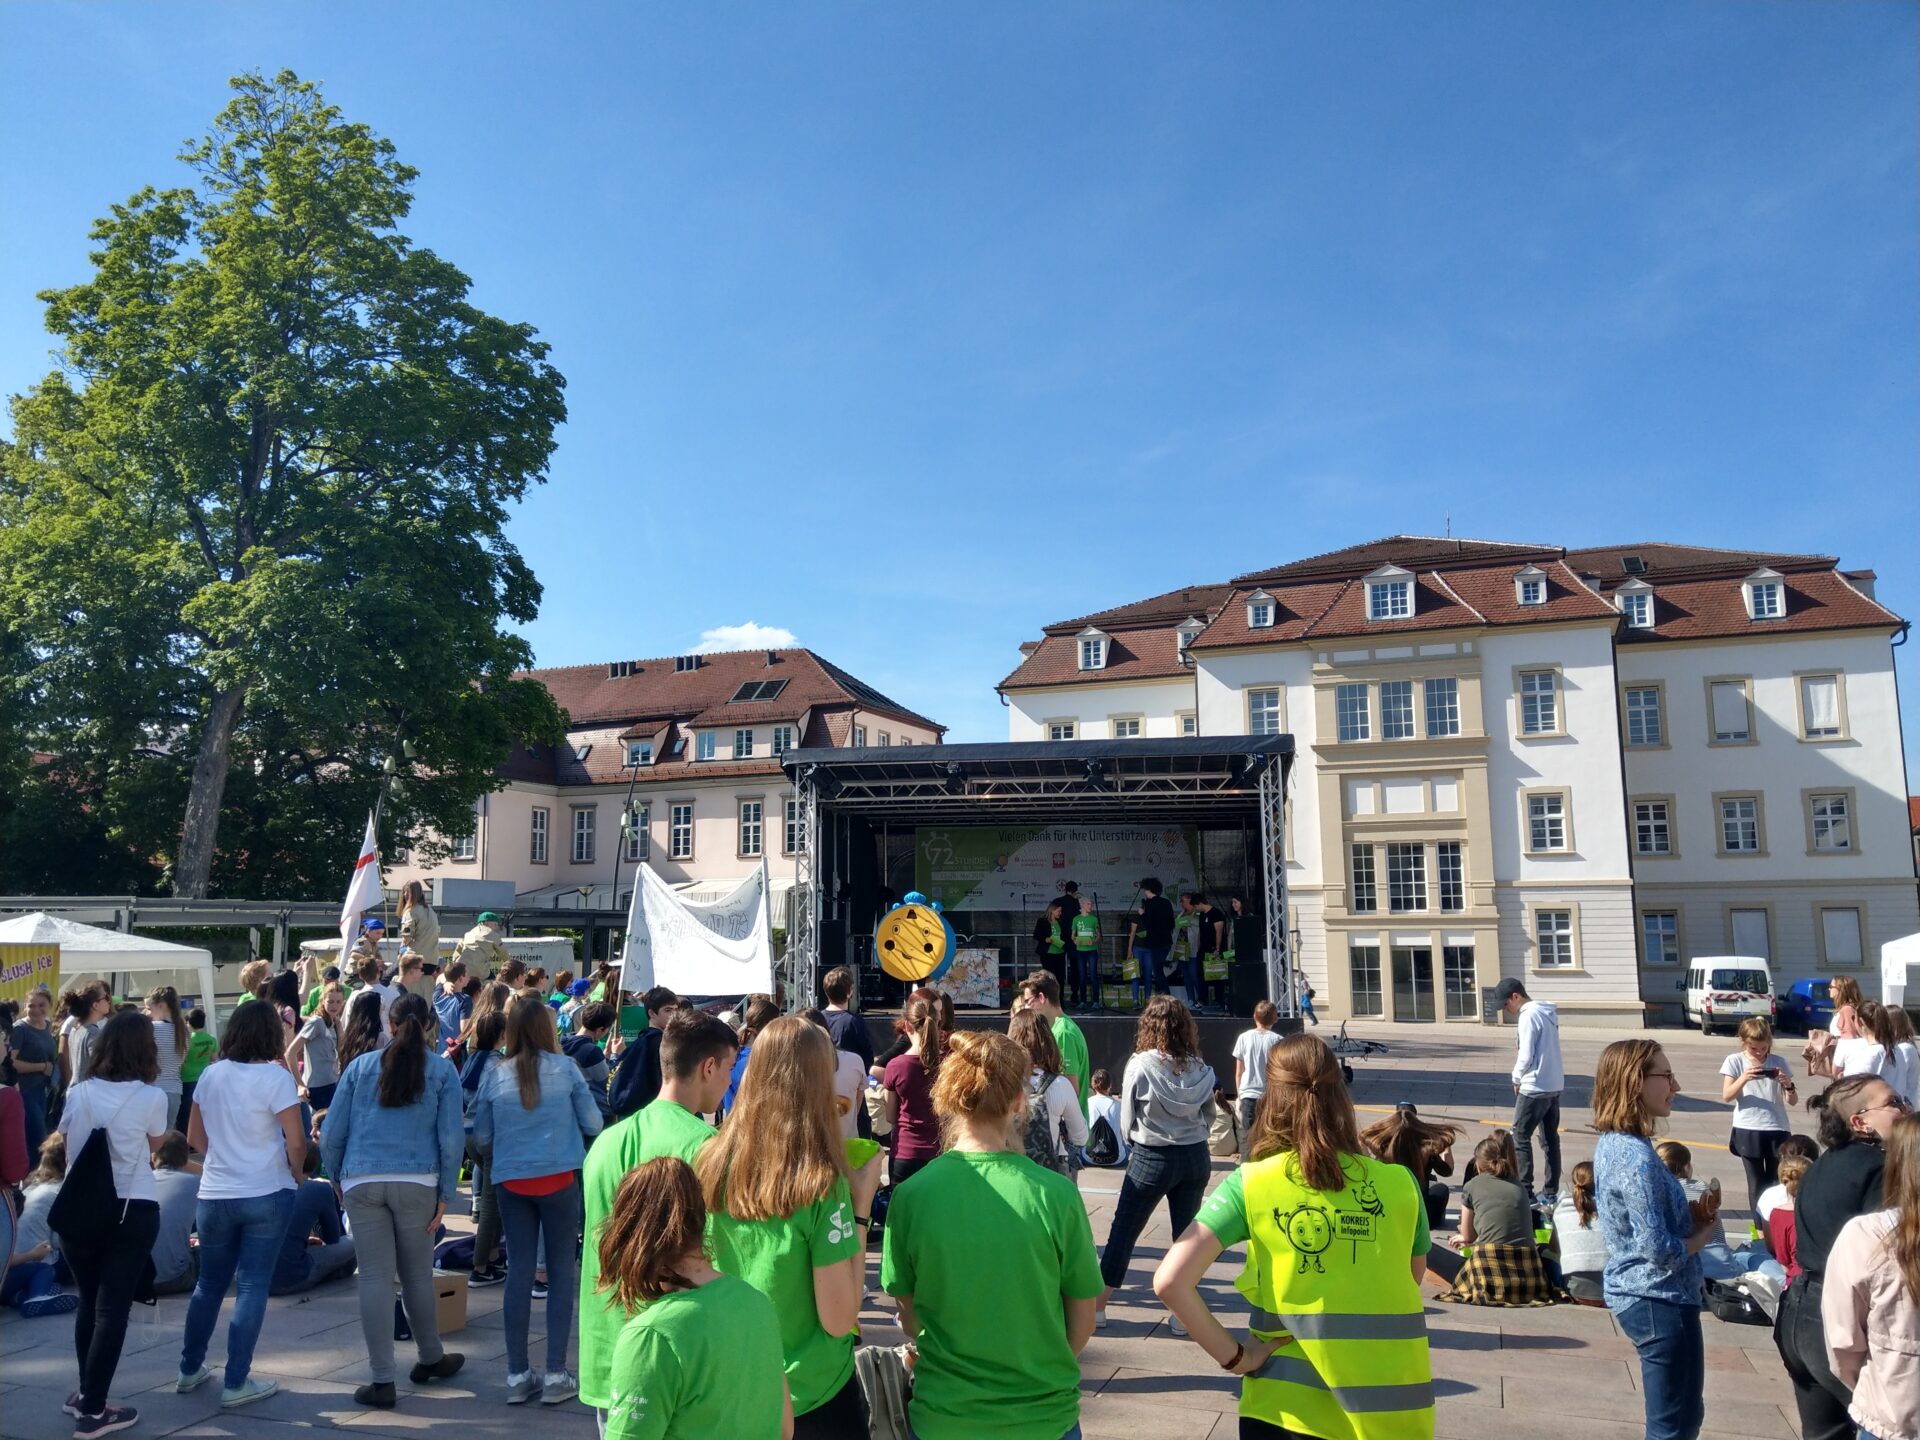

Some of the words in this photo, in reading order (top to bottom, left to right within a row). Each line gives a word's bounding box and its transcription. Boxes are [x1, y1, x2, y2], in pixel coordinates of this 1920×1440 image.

[998, 830, 1026, 843] Vielen
[1028, 830, 1051, 842] Dank
[1054, 829, 1067, 841] für
[930, 847, 954, 865] 72
[954, 856, 990, 865] STUNDEN
[1, 961, 33, 983] SLUSH
[37, 955, 53, 970] ICE
[1340, 1215, 1370, 1226] KOKREIS
[1340, 1226, 1370, 1236] Infopoint
